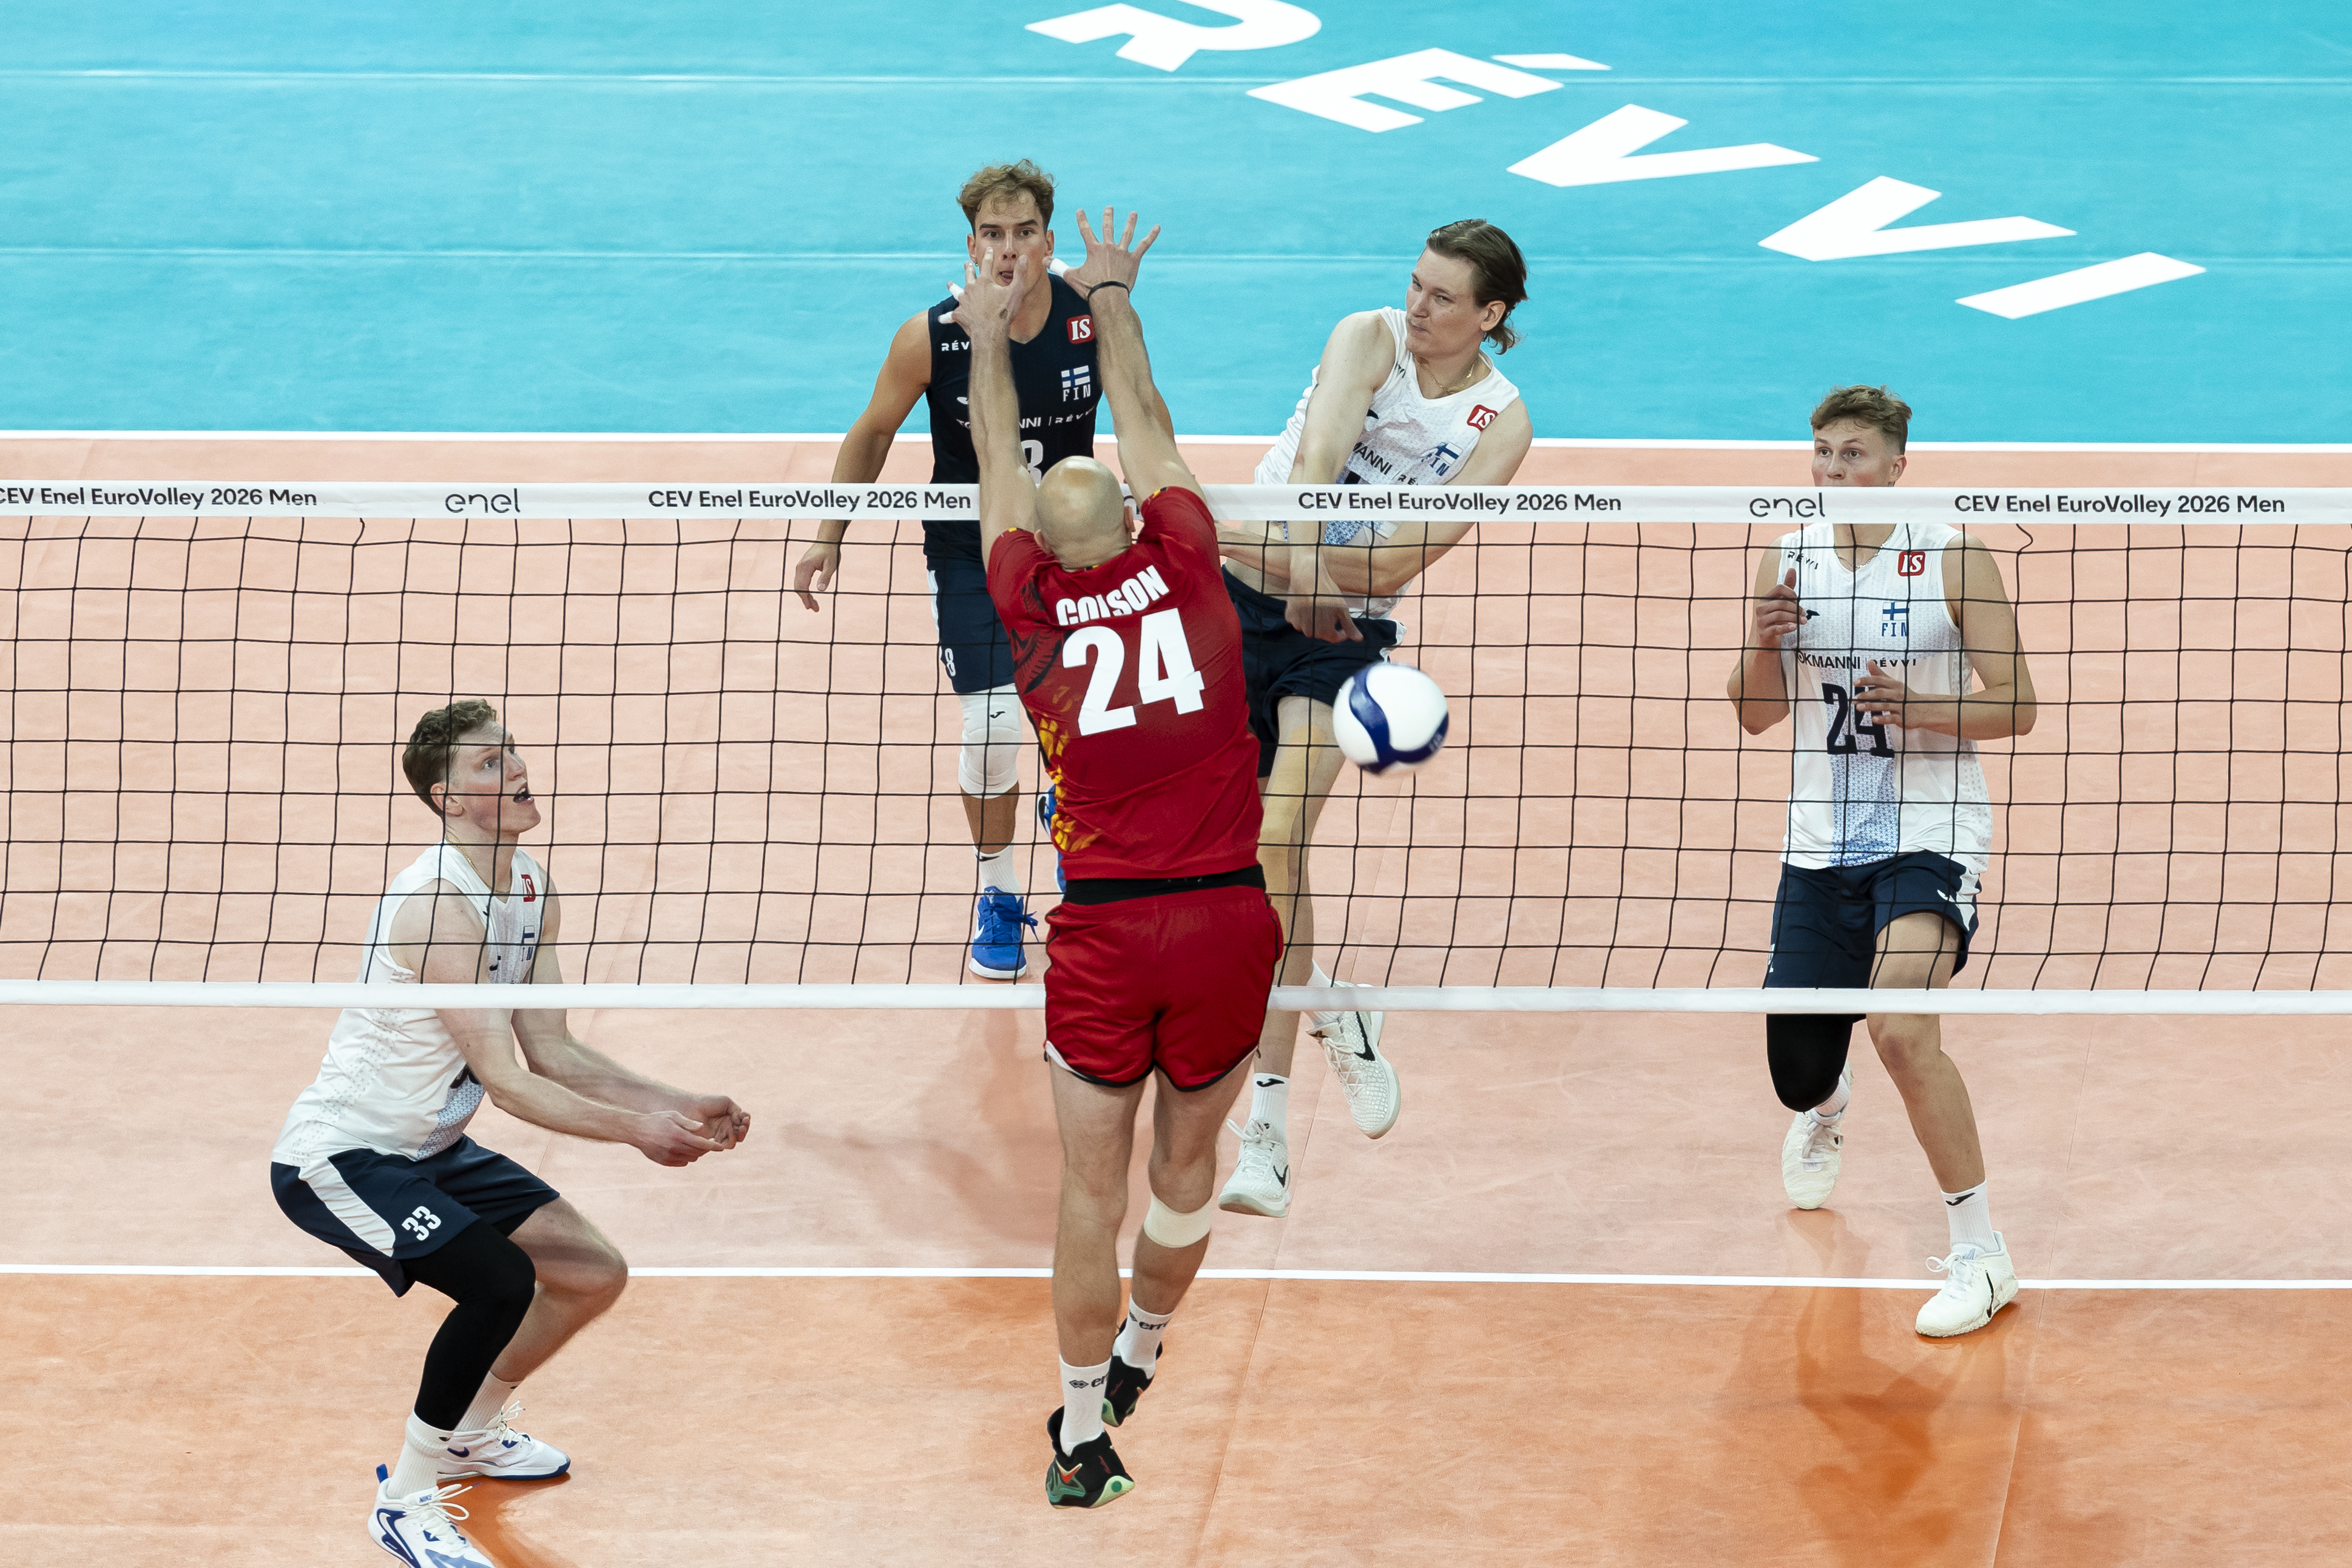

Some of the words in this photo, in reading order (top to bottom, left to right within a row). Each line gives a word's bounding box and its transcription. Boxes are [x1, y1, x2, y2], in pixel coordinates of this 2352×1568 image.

[1071, 319, 1091, 340] IS
[941, 340, 970, 351] RÉV
[1063, 384, 1091, 402] FIN
[1468, 409, 1496, 429] IS
[41, 487, 85, 504] Enel
[91, 487, 204, 510] EuroVolley
[211, 488, 263, 505] 2026
[269, 489, 317, 505] Men
[445, 488, 521, 513] enel
[648, 490, 693, 507] CEV
[699, 490, 742, 507] Enel
[749, 490, 860, 512] EuroVolley
[867, 491, 917, 509] 2026
[924, 492, 971, 509] Men
[1298, 492, 1342, 509] CEV
[1348, 492, 1392, 509] Enel
[1399, 493, 1510, 515] EuroVolley
[1516, 493, 1567, 510] 2026
[1575, 494, 1621, 511] Men
[1749, 492, 1825, 518] enel
[1955, 495, 2000, 512] CEV
[2006, 495, 2050, 512] Enel
[2057, 495, 2171, 518] EuroVolley
[2178, 495, 2230, 513] 2026
[2237, 495, 2285, 513] Men
[1901, 555, 1924, 573] IS
[1882, 623, 1909, 637] FIN
[1794, 650, 1860, 669] OKMANNI
[1062, 607, 1205, 736] 24
[401, 1206, 441, 1241] 33
